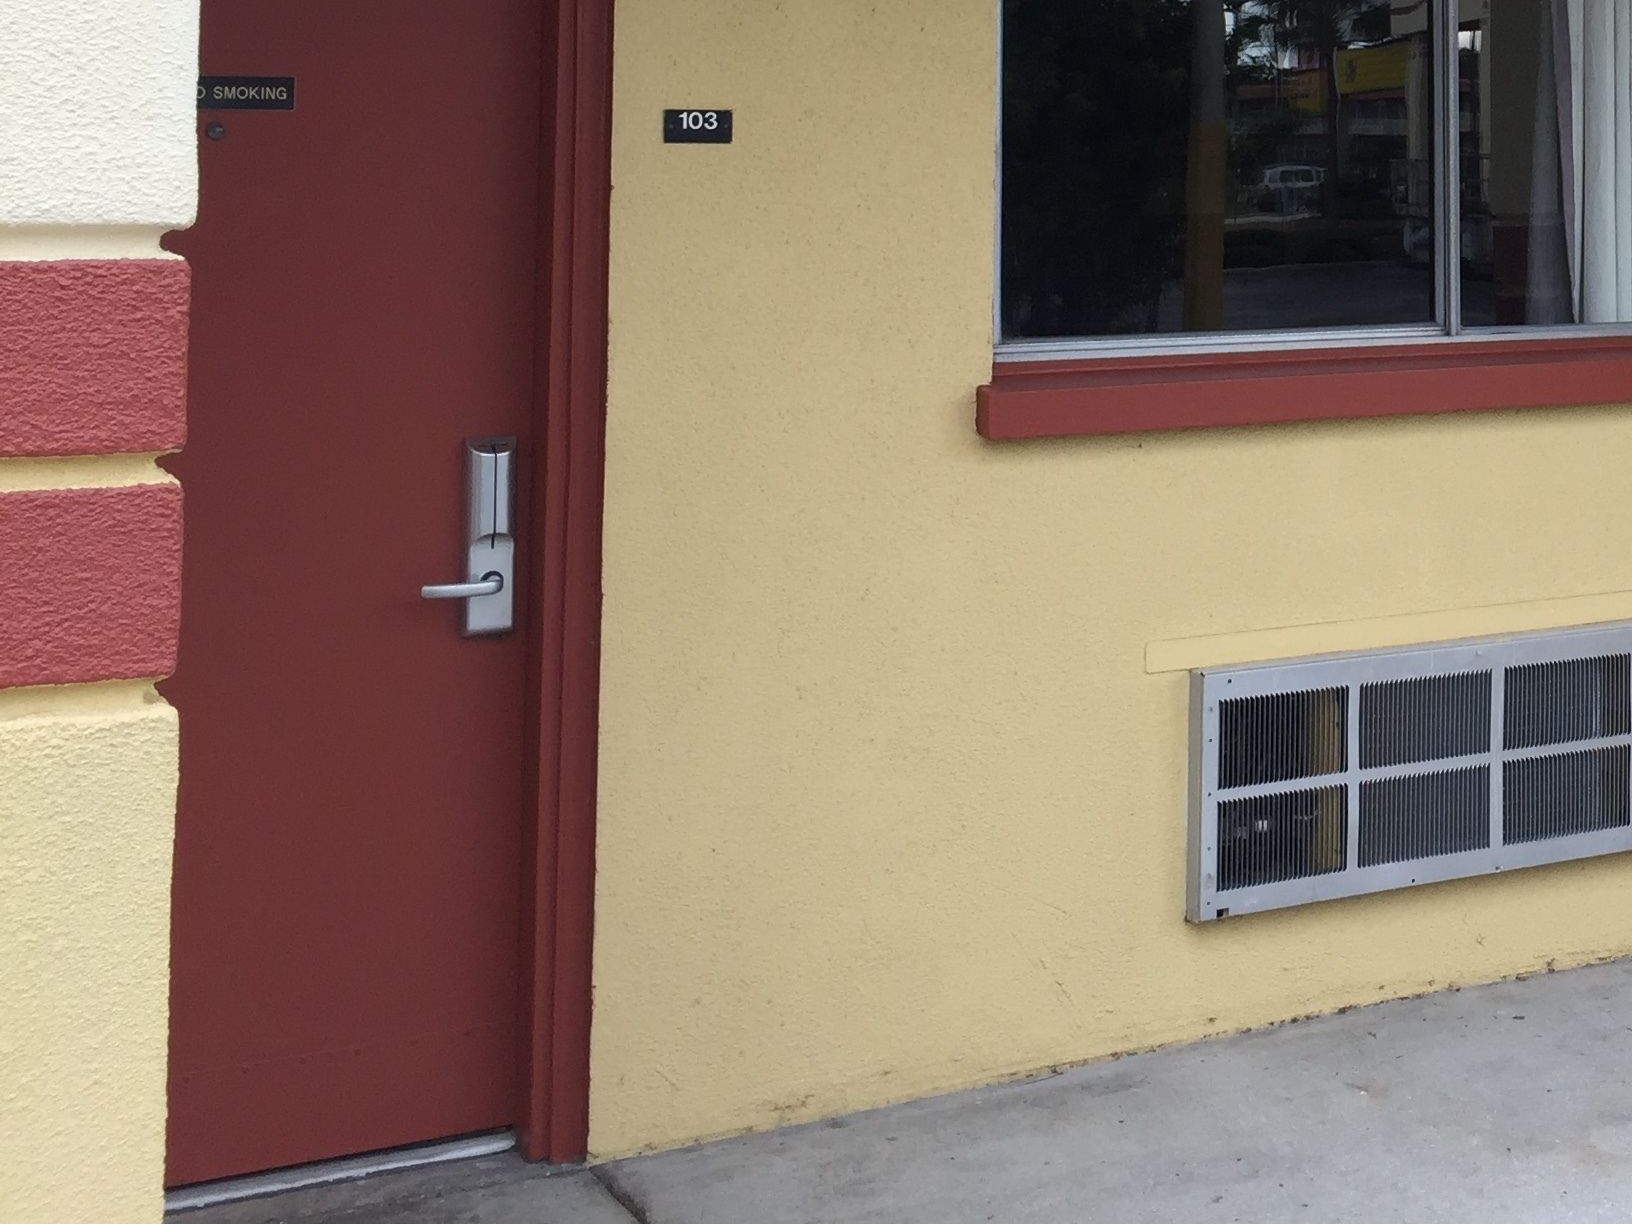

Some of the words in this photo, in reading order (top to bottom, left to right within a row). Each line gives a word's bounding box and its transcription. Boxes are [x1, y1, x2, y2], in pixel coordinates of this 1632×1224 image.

[197, 86, 206, 99] O
[213, 86, 287, 99] SMOKING
[678, 111, 718, 130] 103
